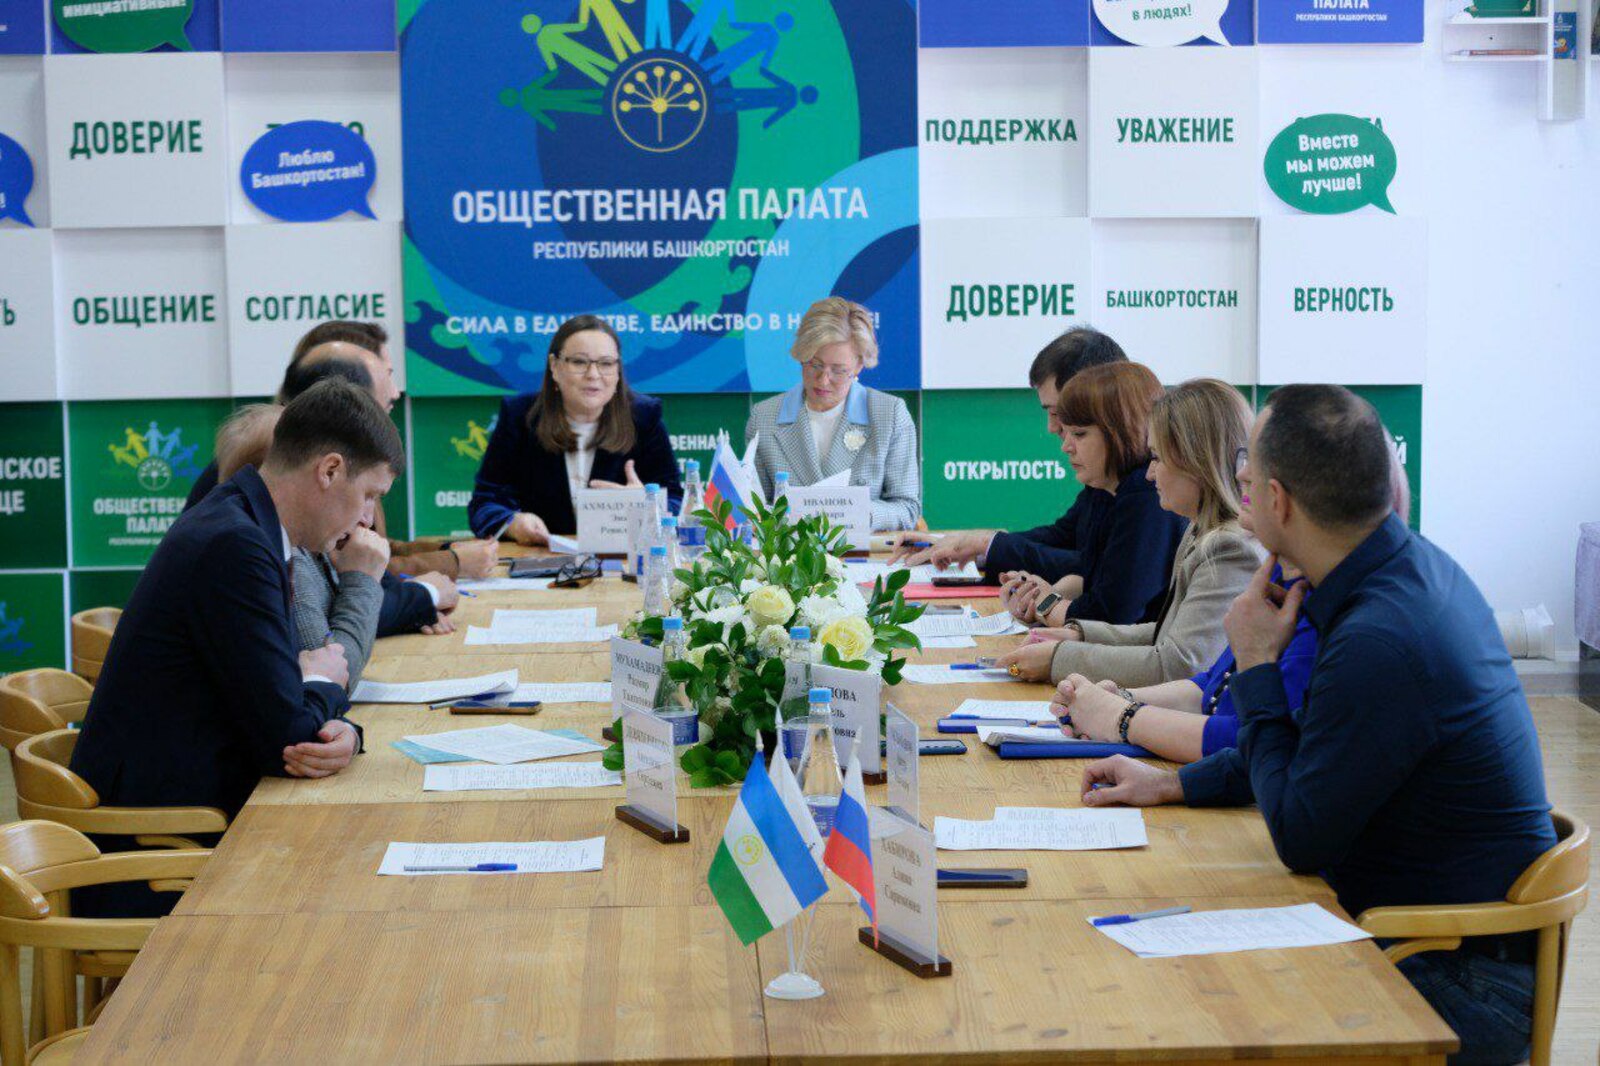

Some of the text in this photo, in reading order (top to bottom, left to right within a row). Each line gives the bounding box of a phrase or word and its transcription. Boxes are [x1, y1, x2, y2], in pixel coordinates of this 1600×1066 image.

[1132, 4, 1191, 20] в людях!
[70, 120, 203, 160] ДОВЕРИЕ
[926, 119, 1077, 145] ПОДДЕРЖКА
[1117, 117, 1234, 143] УВАЖЕНИЕ
[1298, 134, 1359, 151] Вместе
[278, 149, 335, 168] Люблю
[1286, 154, 1375, 174] мы можем
[251, 162, 366, 189] Башкортостан!
[1302, 172, 1362, 197] лучше!
[452, 187, 869, 228] ОБЩЕСТВЕННАЯ ПАЛАТА
[533, 239, 790, 260] РЕСПУБЛИКИ БАШКОРТОСТАН
[73, 295, 216, 328] ОБЩЕНИЕ
[246, 293, 385, 322] СОГЛАСИЕ
[946, 283, 1076, 322] ДОВЕРИЕ
[1106, 289, 1238, 309] БАШКОРТОСТАН
[1294, 286, 1394, 313] ВЕРНОСТЬ
[446, 315, 508, 334] СИЛА
[514, 316, 527, 333] В
[651, 314, 763, 334] ЕДИНСТВО
[769, 314, 781, 330] В
[944, 460, 1066, 481] ОТКРЫТОСТЬ
